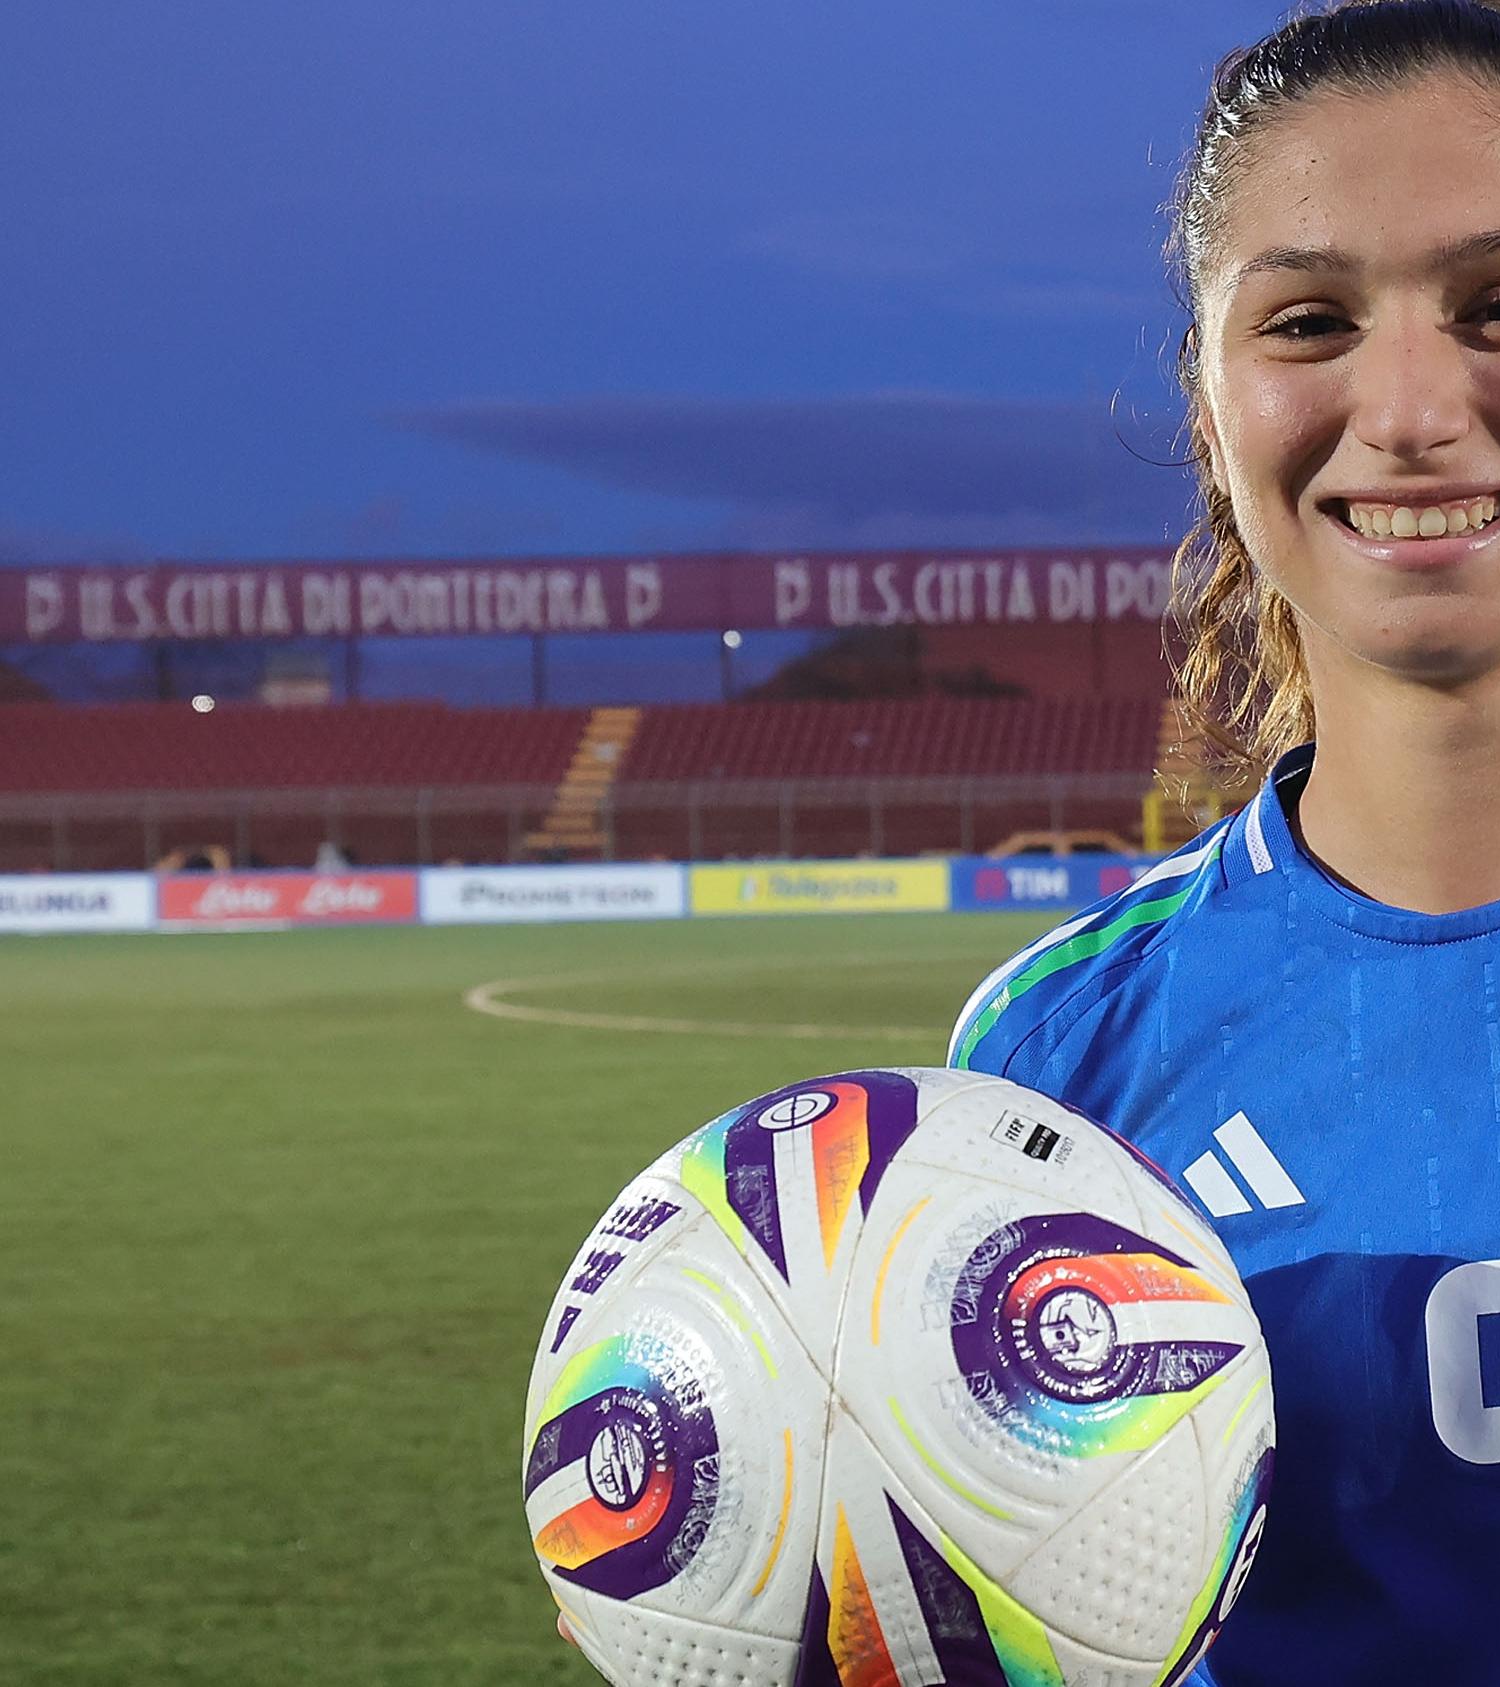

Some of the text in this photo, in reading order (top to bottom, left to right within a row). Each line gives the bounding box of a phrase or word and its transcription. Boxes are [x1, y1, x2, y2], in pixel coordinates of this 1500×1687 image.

[302, 570, 351, 637] DI
[1047, 559, 1094, 623] DI
[1006, 867, 1070, 899] TIM
